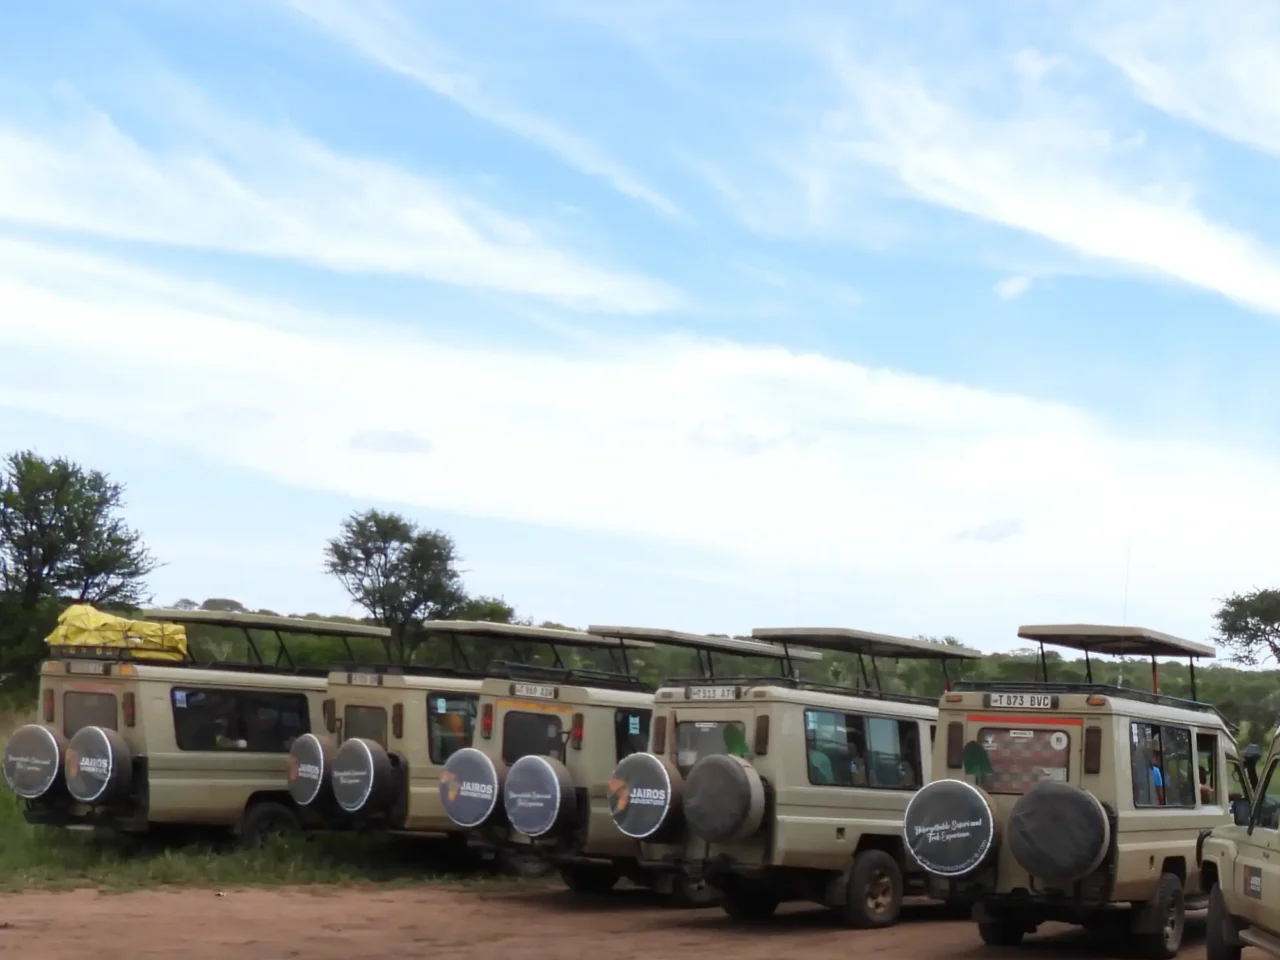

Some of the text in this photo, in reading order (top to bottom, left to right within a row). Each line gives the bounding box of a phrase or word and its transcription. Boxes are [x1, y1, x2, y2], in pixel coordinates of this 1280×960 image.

[998, 694, 1004, 705] T
[1030, 696, 1049, 707] BVC
[460, 781, 493, 794] JAIROS
[630, 788, 666, 800] JAIROS
